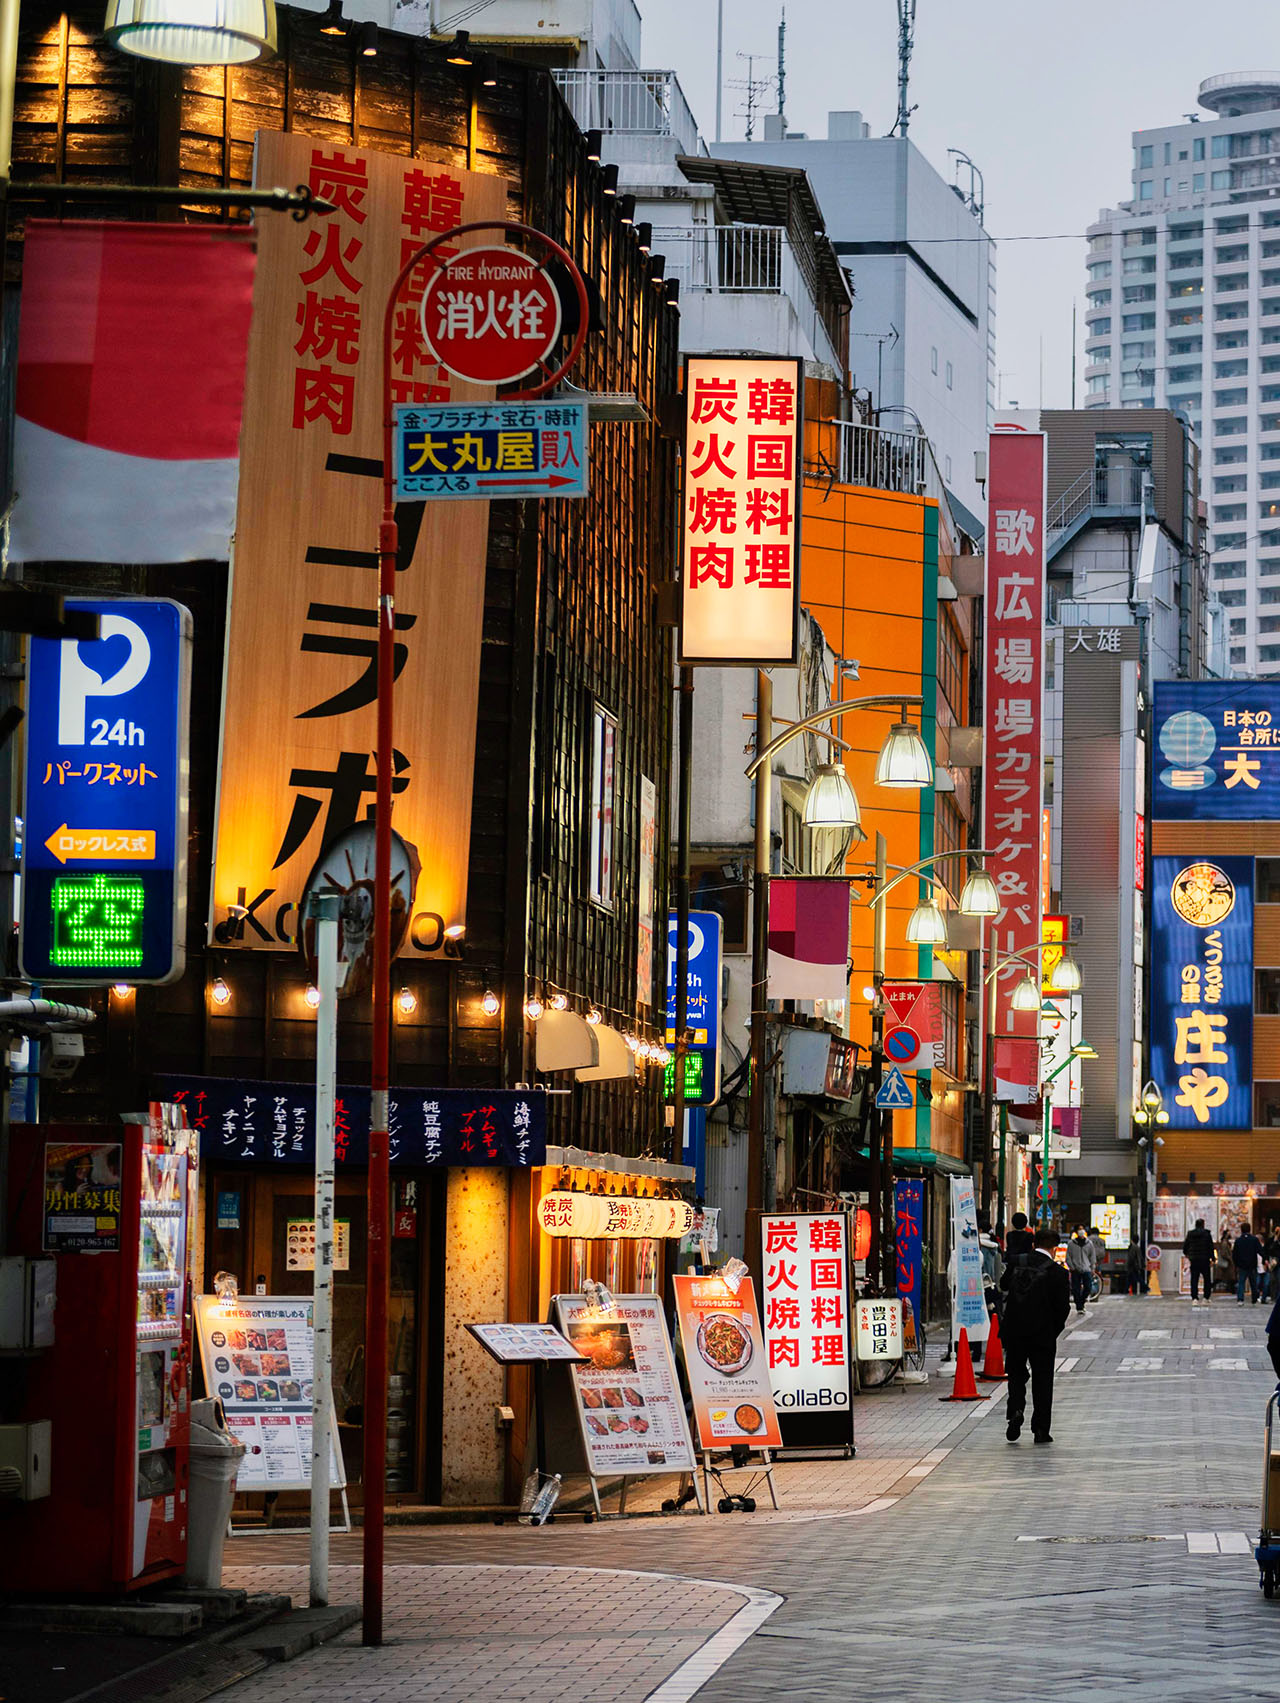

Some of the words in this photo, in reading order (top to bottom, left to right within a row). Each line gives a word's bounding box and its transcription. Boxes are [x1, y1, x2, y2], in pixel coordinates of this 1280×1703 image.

[292, 149, 369, 436] 炭火焼肉
[447, 266, 474, 281] FIRE
[478, 264, 535, 281] HYDRANT
[436, 290, 547, 341] 消火栓
[403, 409, 579, 428] 金・プラチナ・宝石・時計
[408, 433, 536, 472] 大丸屋
[540, 430, 579, 469] 買入
[402, 474, 471, 492] ここ入る
[688, 377, 738, 590] 炭火焼肉
[744, 377, 795, 590] 韓国料理
[1069, 628, 1122, 654] 大雄
[90, 718, 146, 746] 24h
[1224, 710, 1272, 726] 日本の
[43, 761, 158, 786] パークネット
[58, 835, 147, 855] ロックレス式
[51, 874, 145, 967] 空
[1181, 964, 1201, 1004] の里
[1204, 930, 1222, 1004] くつろぎ
[889, 992, 916, 1001] 止まれ
[1174, 1009, 1230, 1123] 庄や
[193, 1091, 210, 1129] チーズ
[222, 1108, 239, 1145] チキン
[241, 1095, 257, 1156] ヤンニョム
[422, 1101, 442, 1163] 純豆腐チゲ
[479, 1105, 497, 1158] サムギョ
[513, 1102, 531, 1165] 海鮮チヂミ
[46, 1189, 121, 1213] 男性募集
[543, 1199, 557, 1227] 焼肉
[558, 1199, 573, 1227] 炭火
[766, 1221, 801, 1369] 炭火焼肉
[809, 1219, 845, 1367] 韓国料理
[872, 1306, 889, 1354] 豊田屋
[889, 1306, 898, 1337] やきとん
